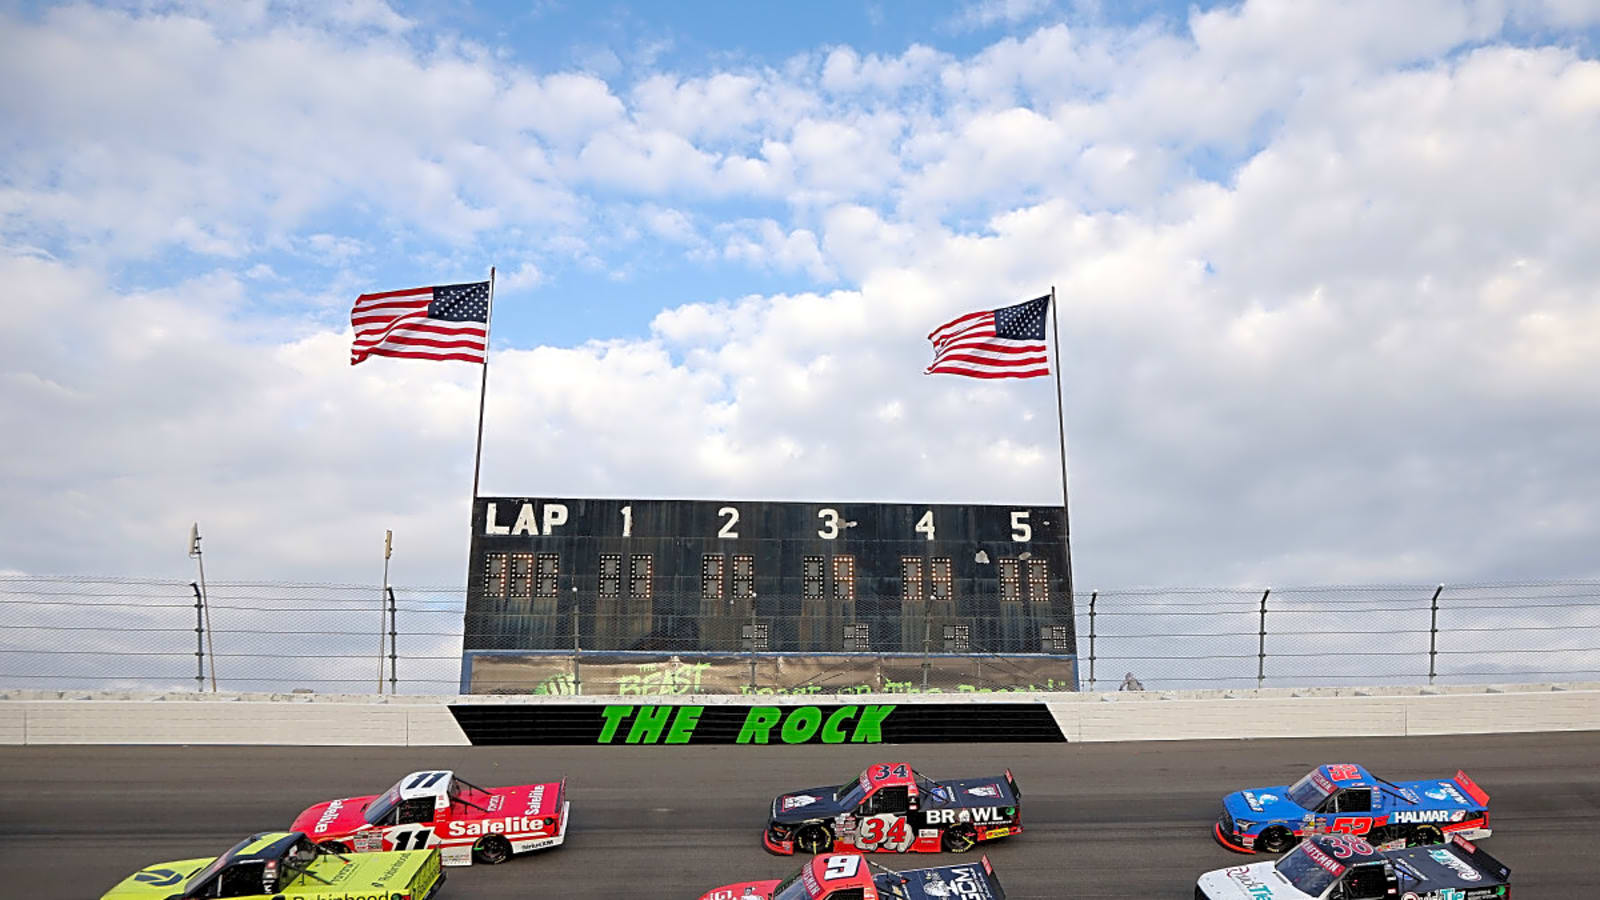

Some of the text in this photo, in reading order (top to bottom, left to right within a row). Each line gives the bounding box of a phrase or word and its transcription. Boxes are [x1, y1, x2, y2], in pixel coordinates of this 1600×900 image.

[485, 502, 1032, 542] LAP 1 2 3 4 5
[597, 705, 897, 744] THE ROCK
[405, 772, 448, 790] 11
[873, 764, 909, 781] 34
[1327, 763, 1362, 782] 52
[448, 816, 545, 836] Safelite
[1332, 816, 1374, 837] 52
[1395, 810, 1449, 824] HALMAR
[393, 830, 432, 851] 11
[861, 816, 908, 845] 34
[1319, 833, 1374, 859] 38
[823, 854, 861, 881] 9
